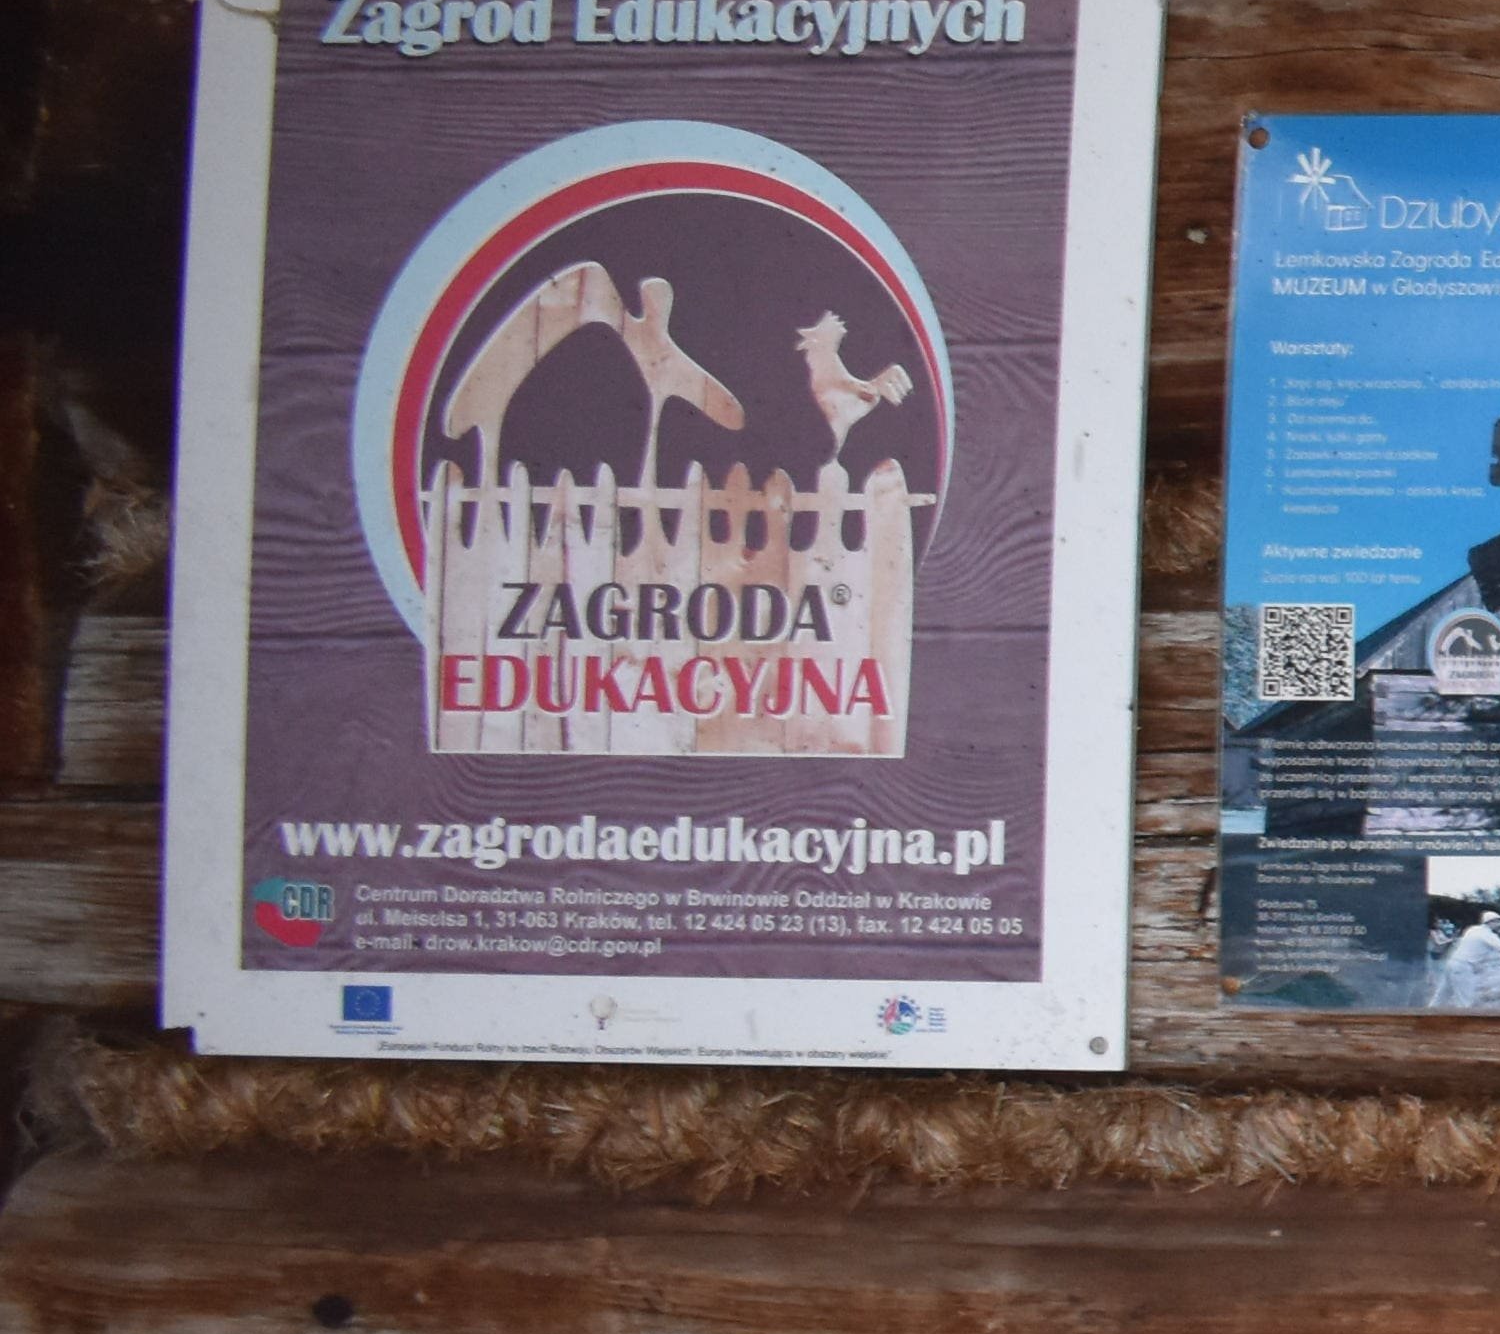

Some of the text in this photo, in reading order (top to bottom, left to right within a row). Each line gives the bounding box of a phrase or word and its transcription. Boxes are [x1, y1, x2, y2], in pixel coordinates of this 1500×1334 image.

[1390, 250, 1472, 273] Zagroda
[1272, 277, 1367, 297] MUZEUM
[441, 654, 891, 717] EDUKACYJNA
[281, 814, 1006, 876] www.zagrodaedukacyjna.pl
[281, 882, 335, 923] CDR
[355, 884, 992, 911] Centrum Doradztwa Rolniczego w Brwinowie Oddział w Krakowie
[355, 911, 379, 927] ul.
[495, 911, 560, 929] 31-063
[563, 912, 643, 932] Kraków,
[647, 914, 678, 931] tel.
[684, 914, 706, 931] 12
[711, 914, 747, 932] 424
[751, 914, 776, 932] 05
[780, 915, 804, 933] 23
[857, 916, 893, 935] fax.
[900, 917, 923, 935] 12
[928, 917, 964, 936] 424
[969, 917, 994, 936] 05
[998, 917, 1023, 936] 05
[354, 935, 663, 959] e-mail: drow.krakow@cdr.gov.pl
